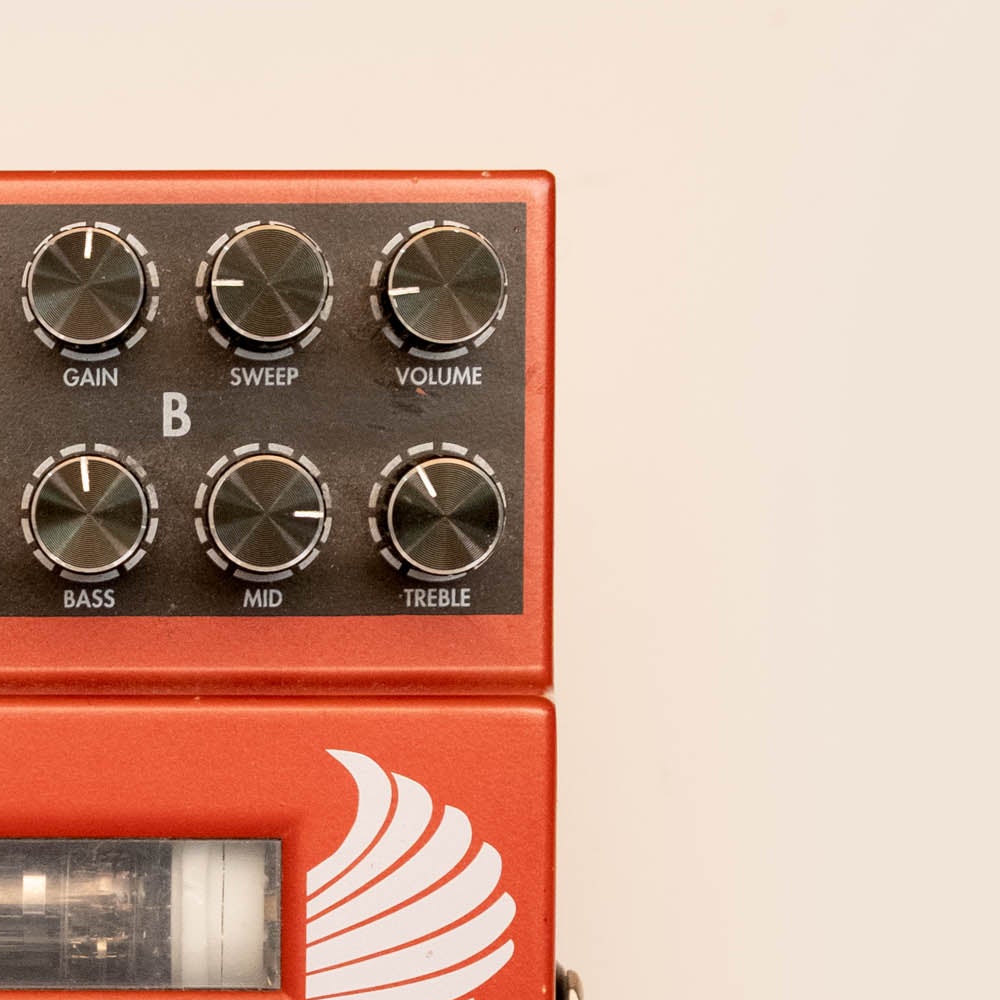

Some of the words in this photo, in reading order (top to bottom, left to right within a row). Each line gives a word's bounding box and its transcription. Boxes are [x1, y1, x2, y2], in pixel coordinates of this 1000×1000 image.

[62, 368, 118, 387] GAIN
[229, 367, 299, 386] SWEEP
[395, 367, 482, 386] VOLUME
[162, 392, 192, 437] B
[63, 589, 116, 608] BASS
[243, 589, 283, 607] MID
[404, 588, 471, 607] TREBLE
